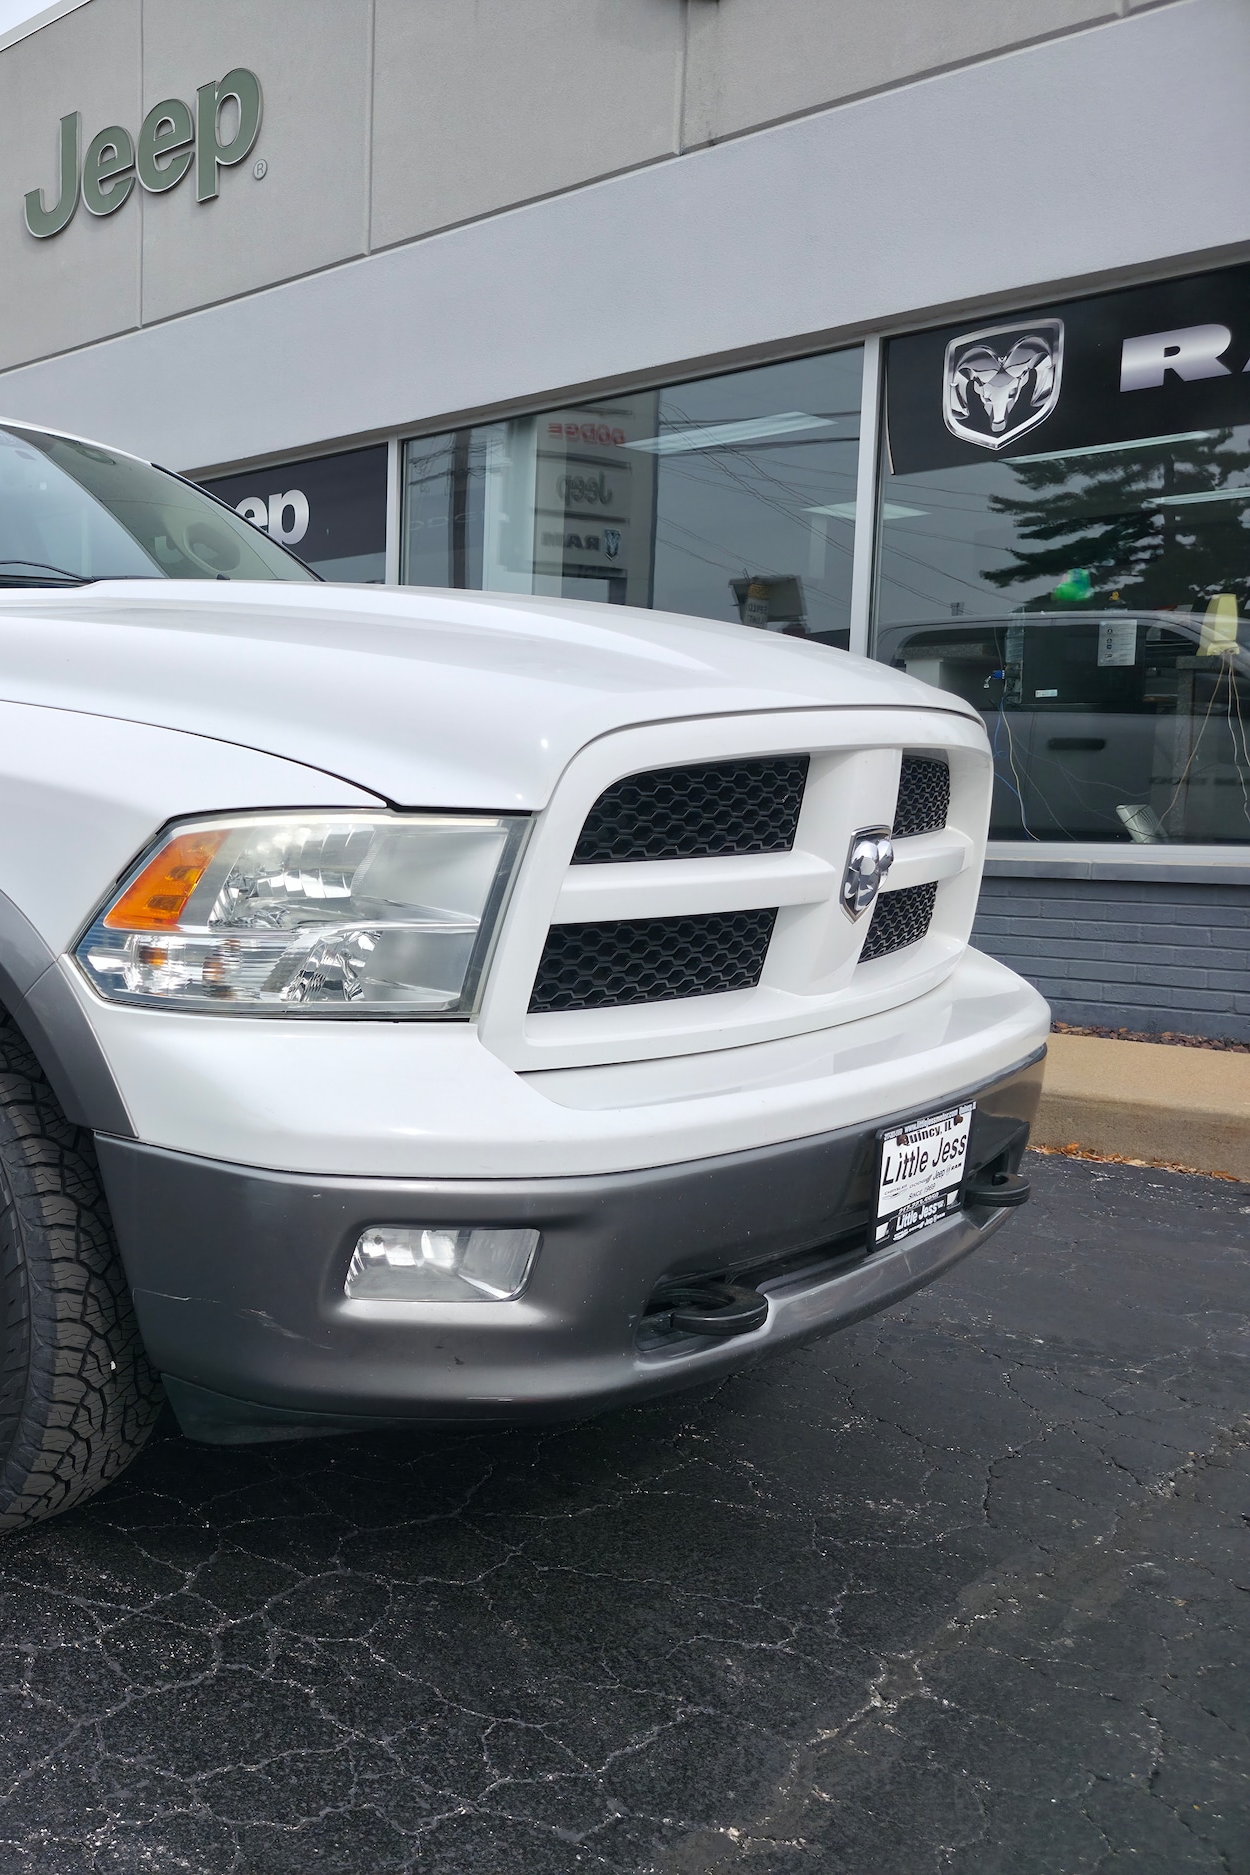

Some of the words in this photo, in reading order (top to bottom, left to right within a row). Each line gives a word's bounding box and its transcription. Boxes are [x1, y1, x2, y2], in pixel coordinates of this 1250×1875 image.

[23, 67, 264, 239] Jeep
[1121, 324, 1250, 393] R
[944, 1121, 952, 1132] IL
[882, 1146, 929, 1187] Little
[932, 1134, 967, 1168] Jess
[895, 1209, 918, 1232] Little
[918, 1202, 937, 1220] Jess
